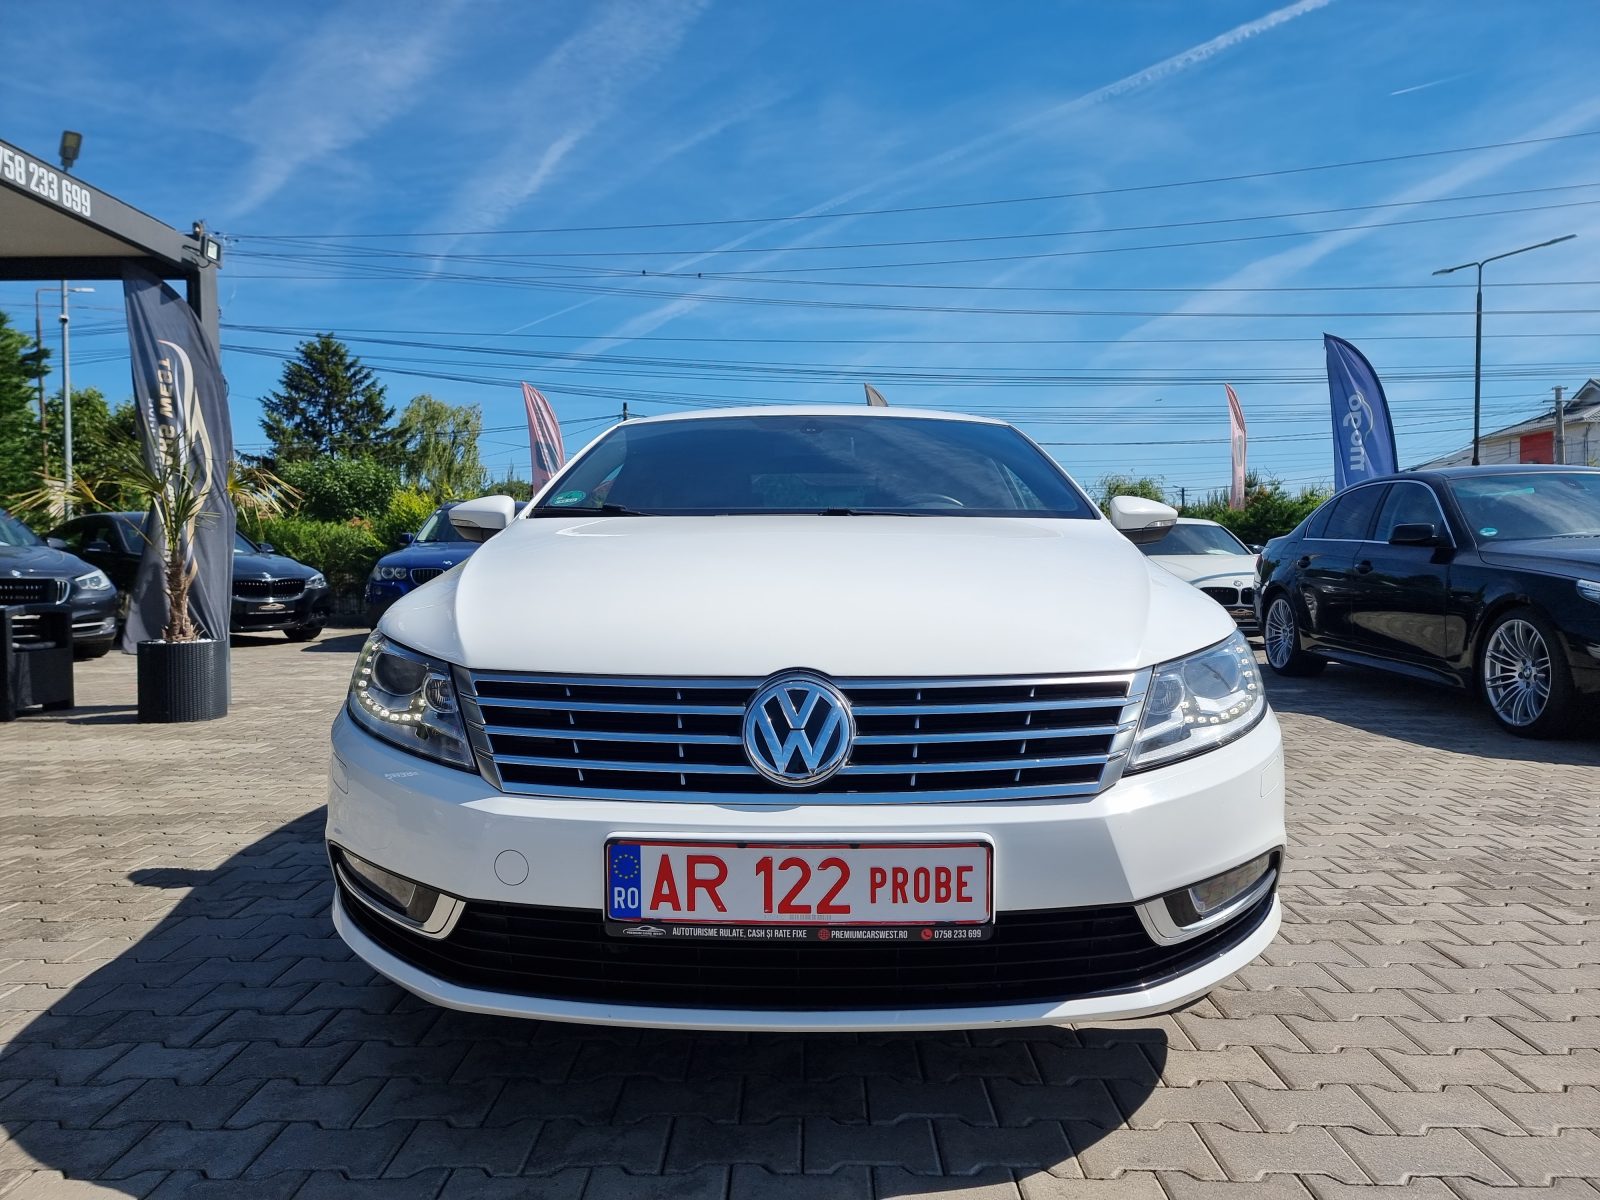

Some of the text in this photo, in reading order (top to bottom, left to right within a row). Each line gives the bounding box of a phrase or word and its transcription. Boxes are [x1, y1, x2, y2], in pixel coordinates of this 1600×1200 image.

[0, 145, 91, 217] 58 233 699
[650, 854, 973, 914] AR 122 PROBE
[613, 887, 639, 909] RO
[672, 927, 718, 937] AUTOTURISME
[719, 928, 746, 938] RULATE,
[747, 929, 765, 938] CASH
[774, 930, 791, 938] RATE
[792, 930, 807, 938] FIXE
[831, 930, 908, 939] PREMIUMCARSWEST.RO
[934, 929, 982, 939] 0758 233 699
